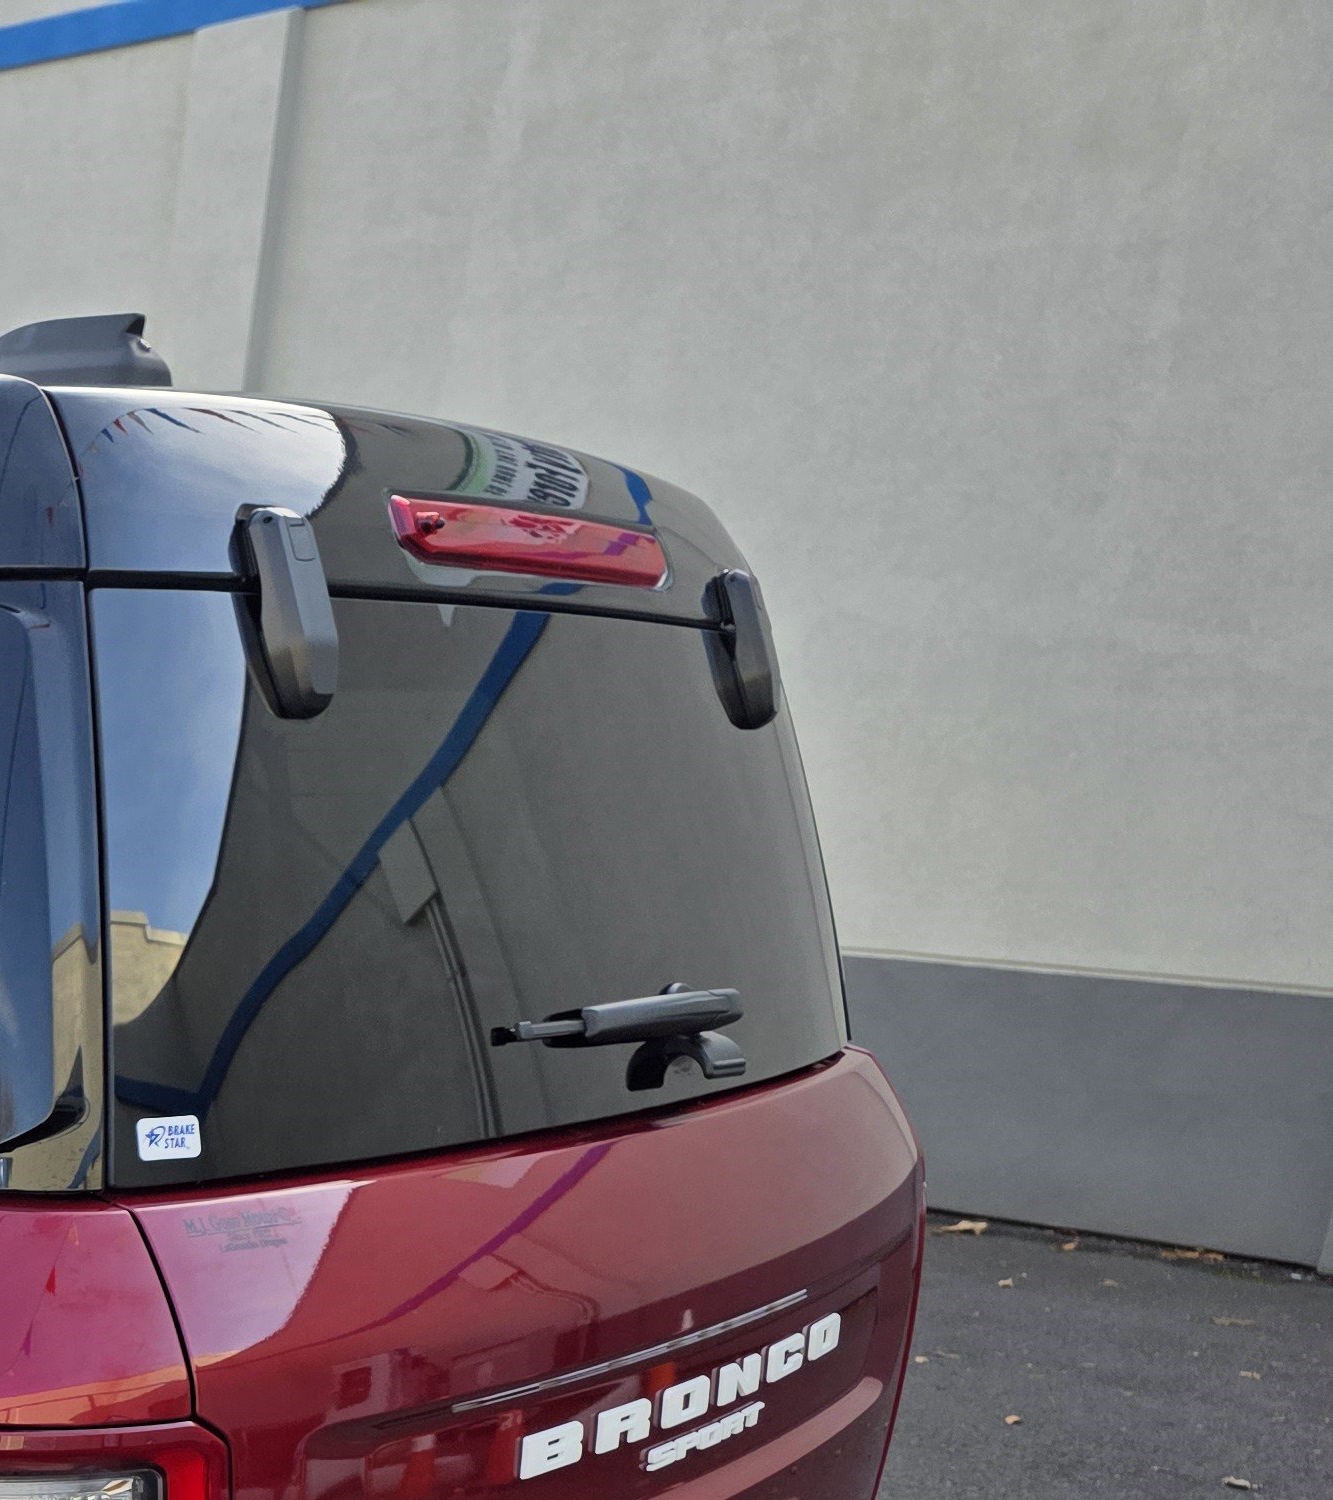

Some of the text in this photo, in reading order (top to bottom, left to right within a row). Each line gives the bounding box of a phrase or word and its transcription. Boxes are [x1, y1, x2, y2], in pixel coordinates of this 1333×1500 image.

[164, 1137, 186, 1149] STAR
[167, 1123, 195, 1136] BRAKE
[519, 1312, 841, 1480] BRONCO
[645, 1401, 765, 1472] SPORT
